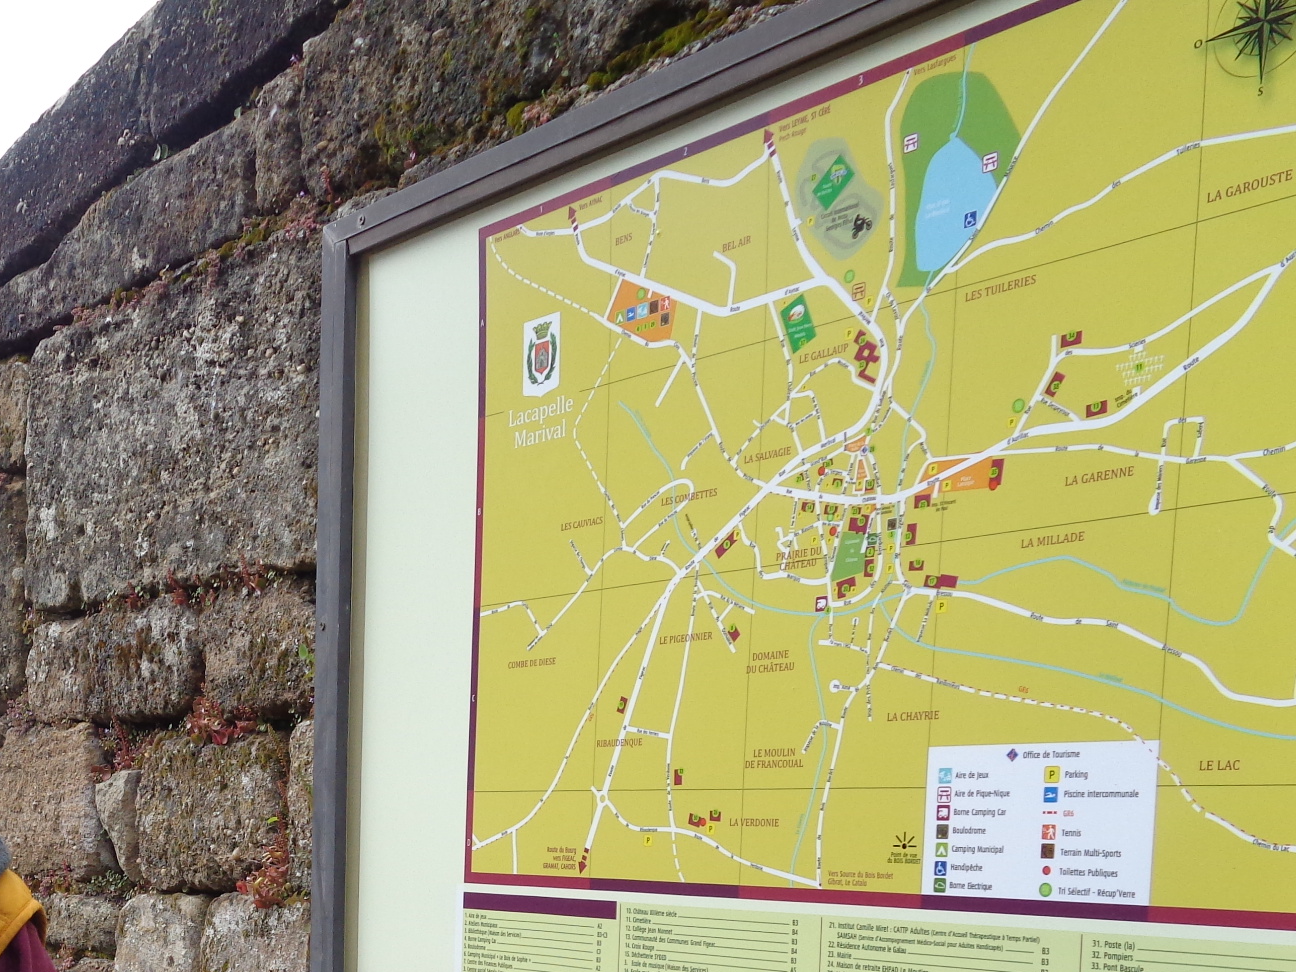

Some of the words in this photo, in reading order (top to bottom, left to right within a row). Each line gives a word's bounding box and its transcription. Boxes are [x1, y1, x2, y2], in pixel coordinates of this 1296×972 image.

[1193, 39, 1203, 49] O
[913, 64, 926, 76] Vers
[926, 54, 957, 72] Lasfargues
[1258, 86, 1264, 96] S
[779, 122, 791, 133] Vers
[1111, 179, 1121, 189] des
[1207, 191, 1222, 204] LA
[1225, 169, 1294, 198] GAROUSTE
[615, 232, 633, 246] BENS
[722, 240, 737, 253] BEL
[738, 235, 751, 249] AIR
[965, 287, 982, 302] LES
[984, 274, 1037, 297] TUILERIES
[799, 354, 809, 364] LE
[810, 343, 849, 361] GALLAUP
[508, 395, 574, 427] Lacapelle
[514, 420, 566, 448] Marival
[744, 454, 754, 464] LA
[755, 446, 791, 463] SALVAGIE
[1065, 475, 1079, 487] LA
[1080, 465, 1134, 484] GARENNE
[661, 496, 673, 506] LES
[675, 488, 718, 504] COMBETTES
[560, 522, 572, 532] LES
[573, 516, 603, 530] CAUVIACS
[1020, 538, 1034, 549] LA
[1036, 531, 1085, 547] MILLADE
[775, 548, 807, 562] PRAIRIE
[810, 546, 822, 557] DU
[779, 557, 817, 572] CHÂTEAU
[1030, 612, 1044, 622] Route
[1106, 619, 1119, 629] Saint
[659, 636, 668, 645] LE
[669, 631, 713, 644] PIGEONNIER
[752, 650, 789, 661] DOMAINE
[508, 659, 527, 669] COMBE
[528, 659, 536, 667] DE
[537, 657, 556, 667] DIESE
[746, 664, 759, 674] DU
[760, 661, 795, 673] CHÂTEAU
[887, 712, 898, 722] LA
[899, 710, 939, 721] CHAYRIE
[597, 738, 643, 748] RIBAUDENQUE
[753, 749, 762, 758] LE
[764, 747, 796, 758] MOULIN
[1023, 750, 1041, 759] Office
[1043, 750, 1050, 758] de
[1052, 749, 1080, 758] Tourisme
[745, 759, 755, 769] DE
[756, 758, 804, 769] FRANCOUAL
[1199, 760, 1214, 771] LE
[1217, 760, 1240, 770] LAC
[955, 771, 967, 779] Aire
[969, 771, 976, 779] de
[977, 771, 989, 780] Jeux
[1065, 770, 1088, 780] Parking
[954, 789, 966, 797] Aire
[967, 789, 974, 797] de
[976, 789, 1010, 799] Pique-Nique
[1063, 790, 1085, 799] Piscine
[1087, 790, 1139, 798] intercommunale
[953, 808, 970, 816] Borne
[971, 808, 994, 818] Camping
[996, 808, 1006, 816] Car
[729, 818, 739, 827] LA
[741, 818, 780, 828] VERDONIE
[952, 826, 986, 835] Boulodrome
[1062, 829, 1081, 837] Tennis
[951, 845, 975, 855] Camping
[977, 845, 1004, 855] Municipal
[1252, 839, 1271, 850] Chemin
[1060, 848, 1081, 857] Terrain
[1084, 849, 1121, 858] Multi-Sports
[950, 863, 983, 872] Handipêche
[1060, 868, 1086, 876] Toilettes
[1088, 868, 1118, 878] Publiques
[949, 882, 965, 890] Borne
[967, 882, 992, 891] Electrique
[1058, 887, 1066, 895] Tri
[1068, 887, 1091, 896] Sélectif
[1097, 888, 1136, 898] Récup'Verre
[1092, 939, 1102, 948] 31.
[1104, 941, 1122, 949] Poste
[1124, 941, 1135, 951] (la)
[1092, 951, 1102, 959] 32.
[1104, 952, 1133, 962] Pompiers
[1091, 962, 1101, 971] 33.
[1103, 963, 1118, 971] Pont
